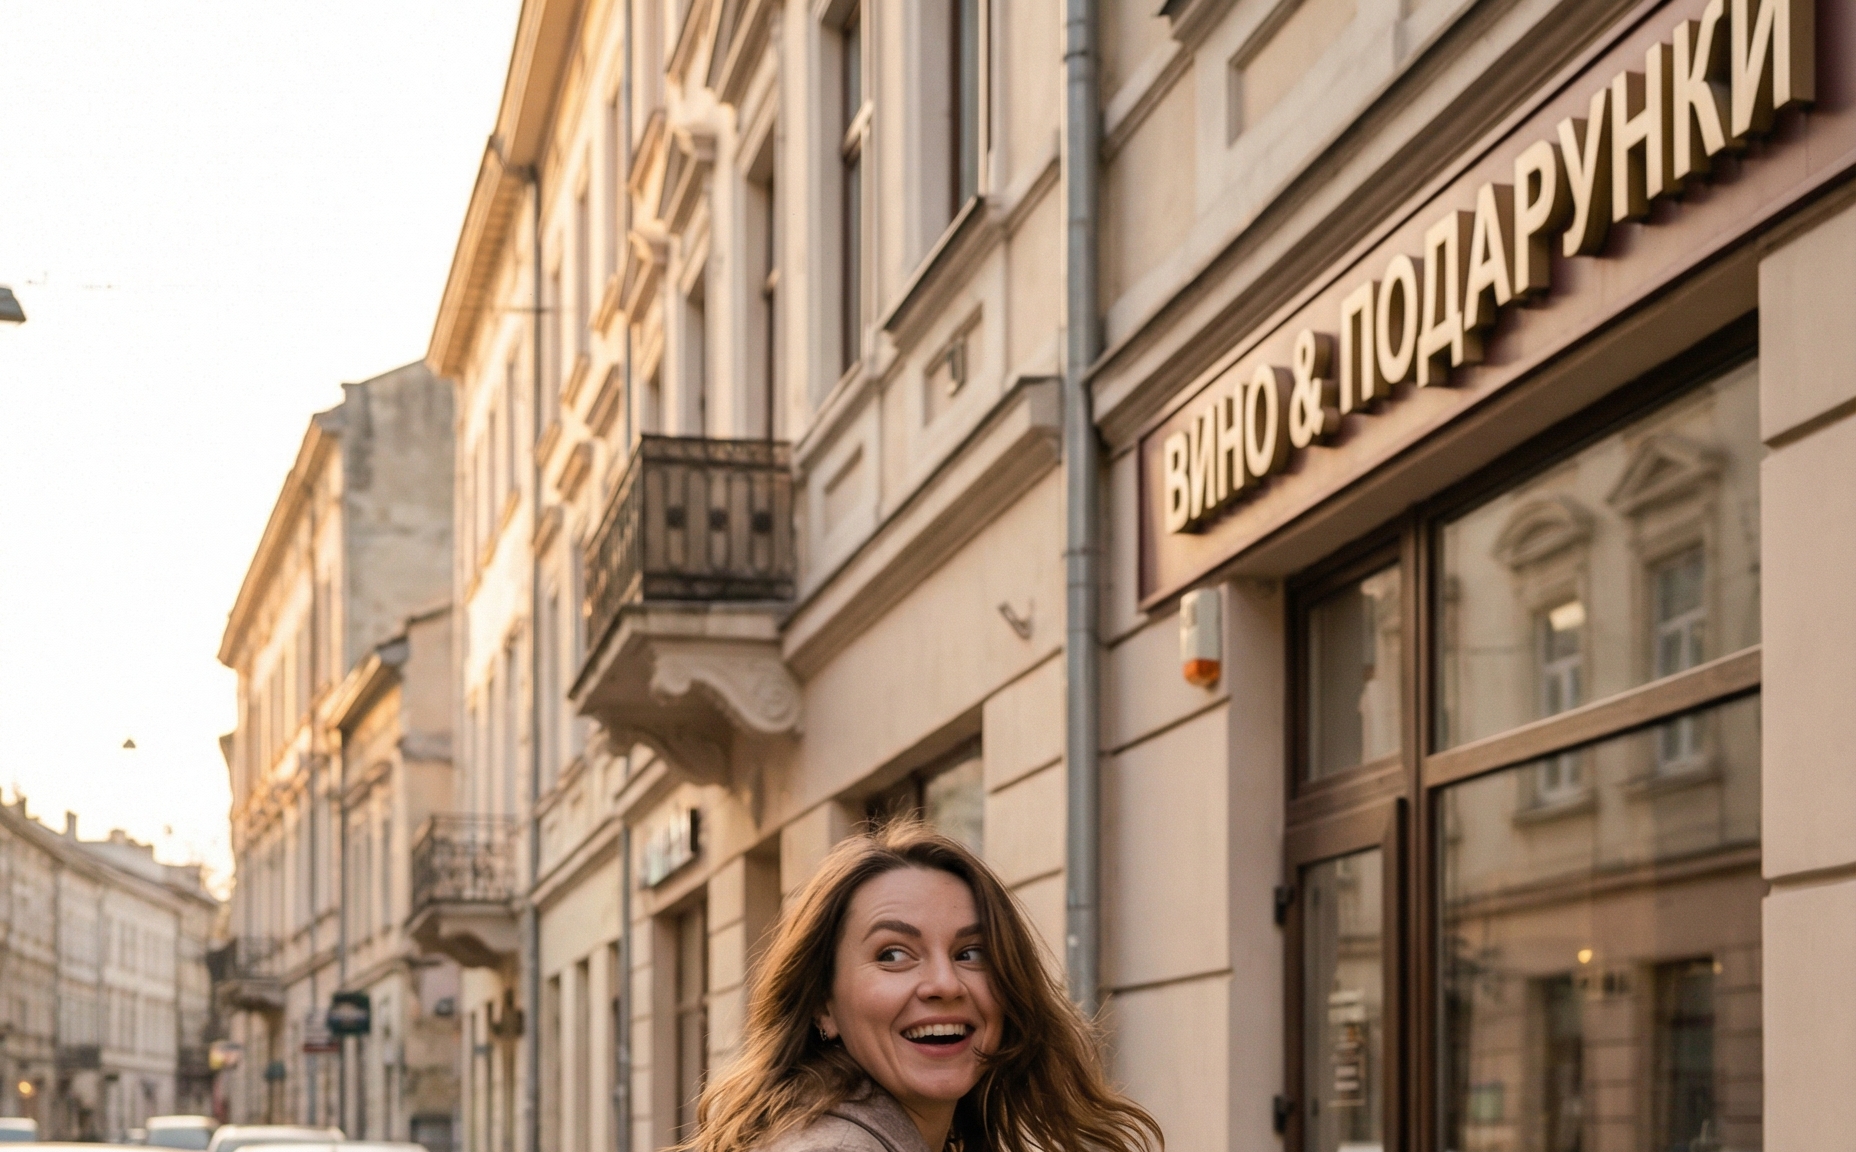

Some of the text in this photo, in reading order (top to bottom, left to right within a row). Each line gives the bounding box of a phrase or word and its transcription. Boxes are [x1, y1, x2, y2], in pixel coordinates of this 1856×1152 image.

[1164, 0, 1791, 534] ВИНО & ПОДАРУНКИ
